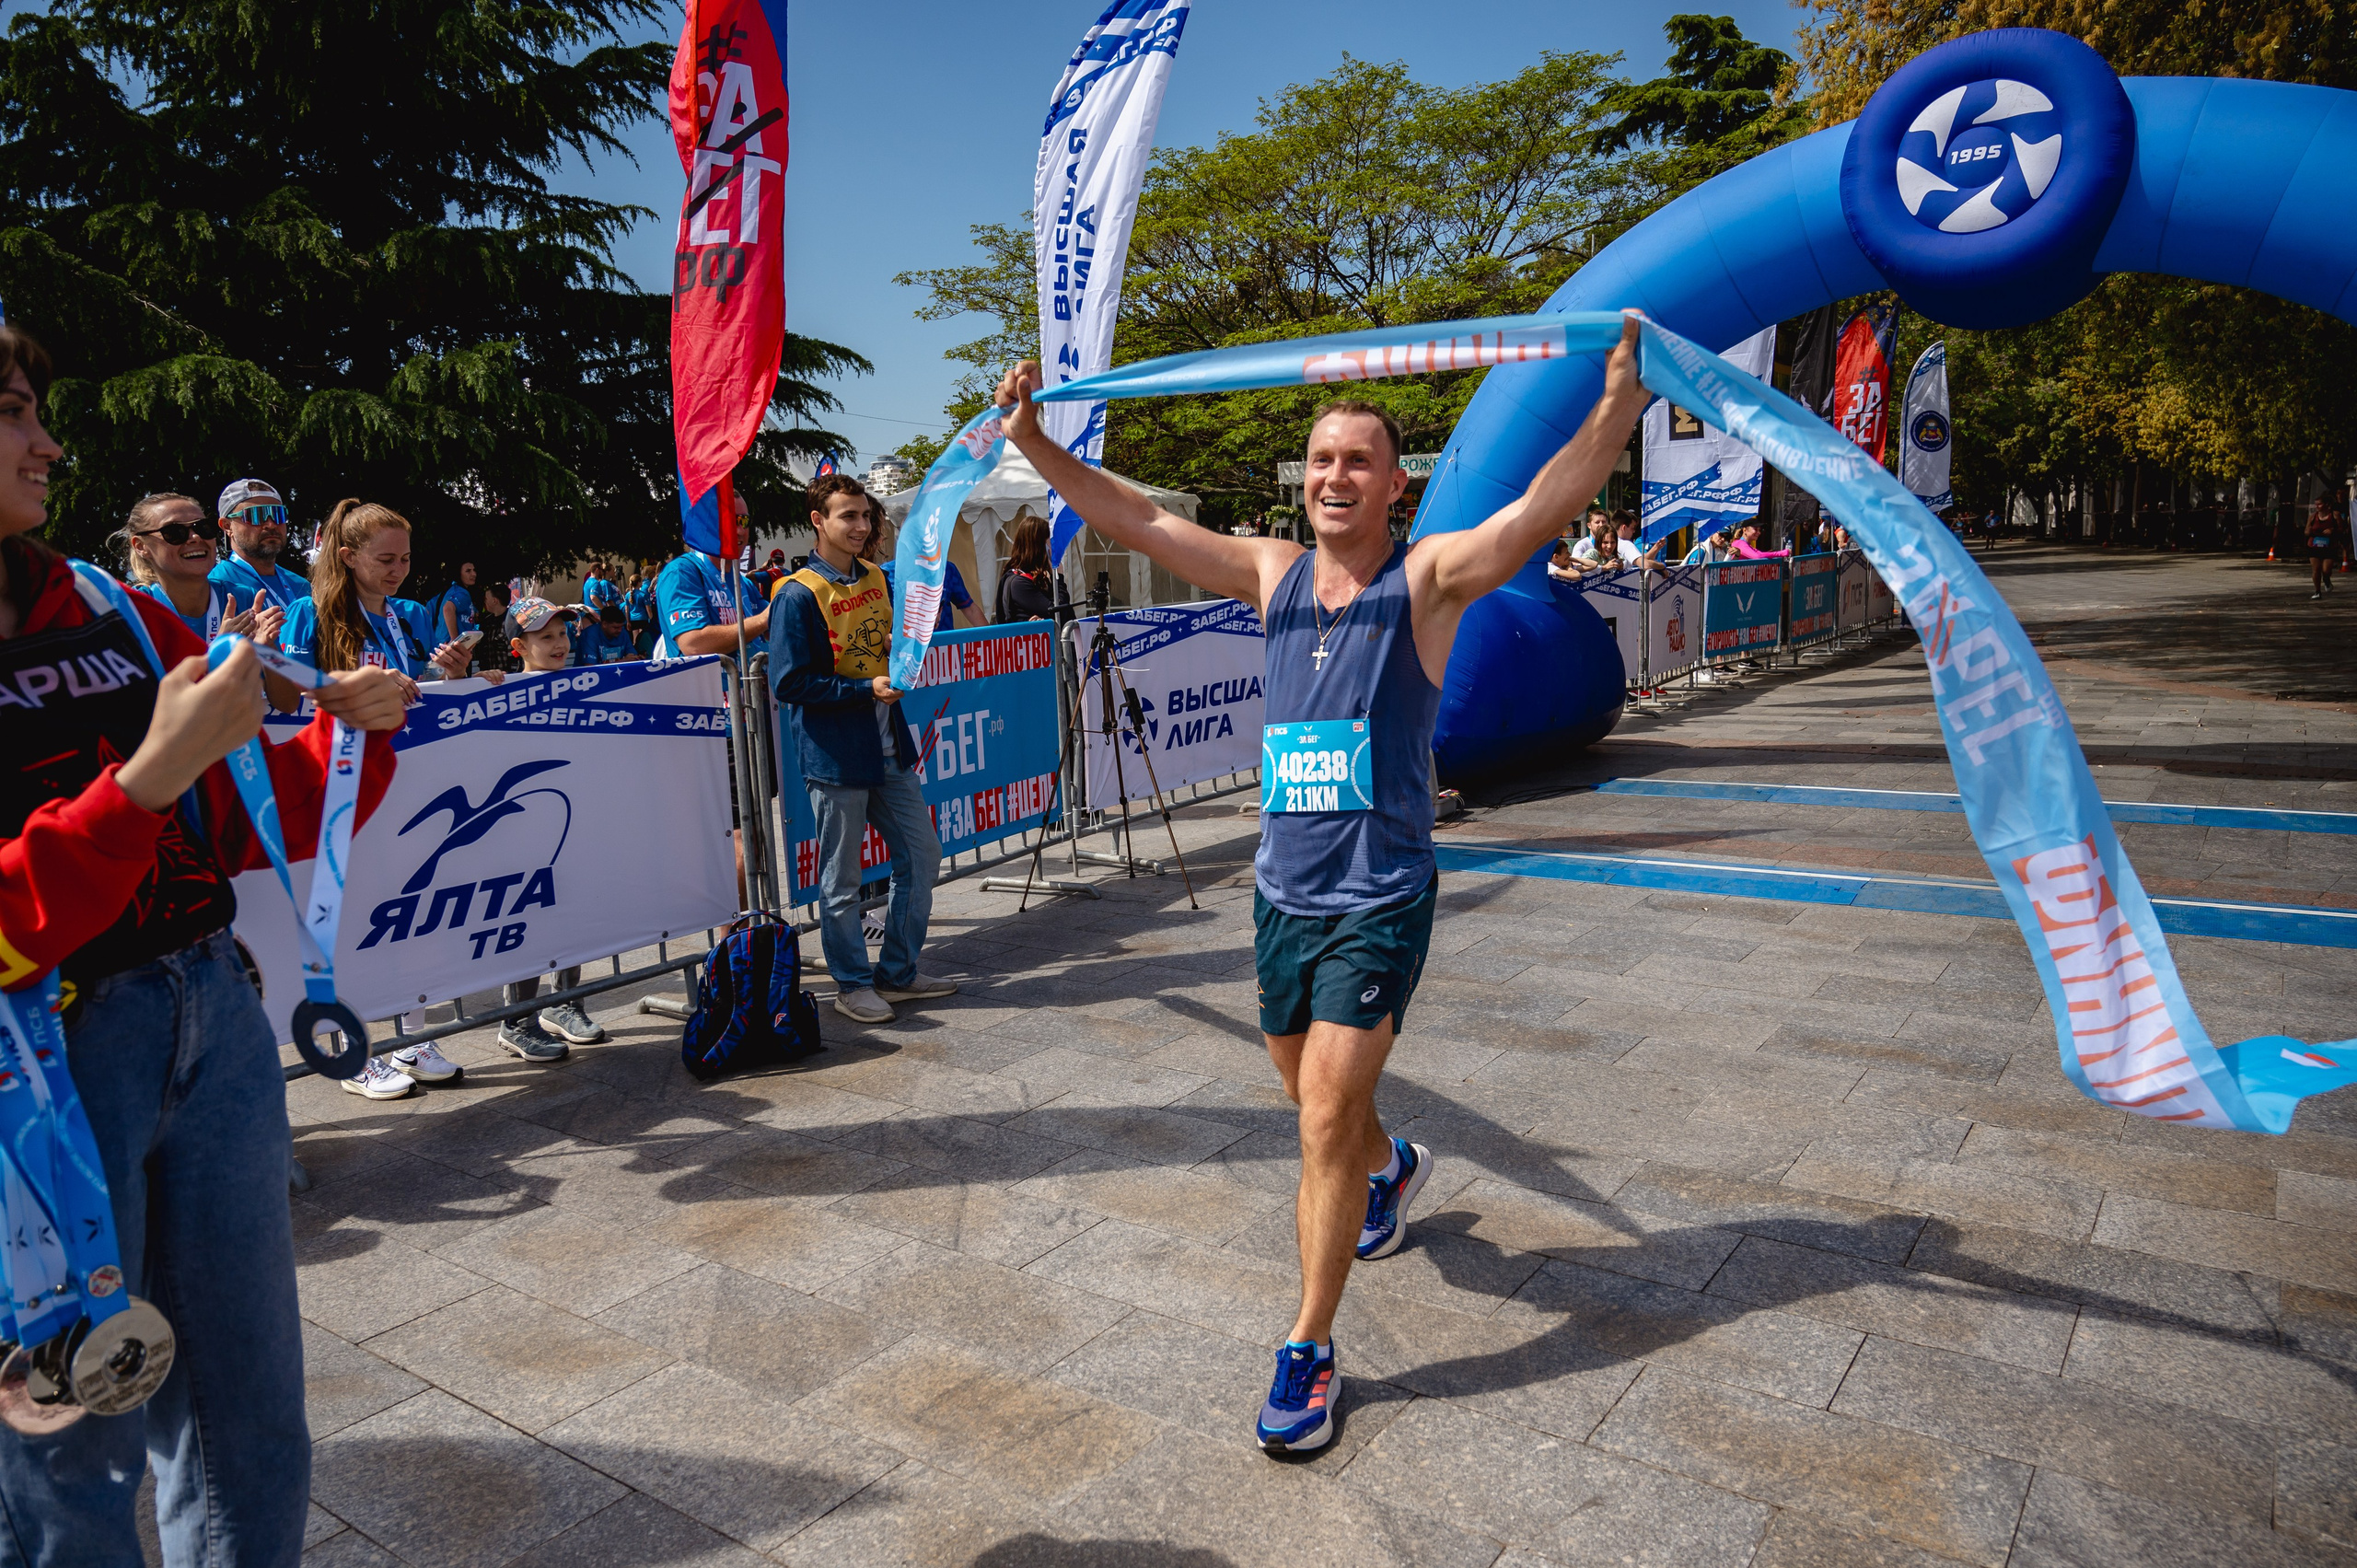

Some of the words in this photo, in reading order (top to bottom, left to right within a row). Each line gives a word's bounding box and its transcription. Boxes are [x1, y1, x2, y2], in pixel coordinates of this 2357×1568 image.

[1950, 144, 2003, 165] 1995
[1054, 128, 1087, 321] ВЫСШАЯ
[1848, 381, 1882, 414] ЗА
[1596, 585, 1620, 595] БЕГ.РФ
[389, 617, 398, 630] ПСБ
[681, 610, 703, 619] ПСБ
[1216, 621, 1264, 633] БЕГ.РФ
[964, 632, 1051, 680] #ЕДИНСТВО
[438, 671, 599, 730] ЗАБЕГ.РФ
[1167, 675, 1266, 716] ВЫСША
[505, 708, 633, 727] БЕГ.РФ
[1165, 713, 1234, 750] ЛИГА
[1274, 727, 1287, 736] ПСБ
[908, 709, 990, 785] АБЕГ
[1278, 749, 1348, 783] 40238
[939, 785, 1004, 843] #ЗАБЕГ
[1006, 772, 1058, 822] #ЦЕЛЬ
[355, 865, 556, 951] ЯЛТА
[469, 922, 527, 960] ТВ
[28, 1006, 47, 1044] ПСБ
